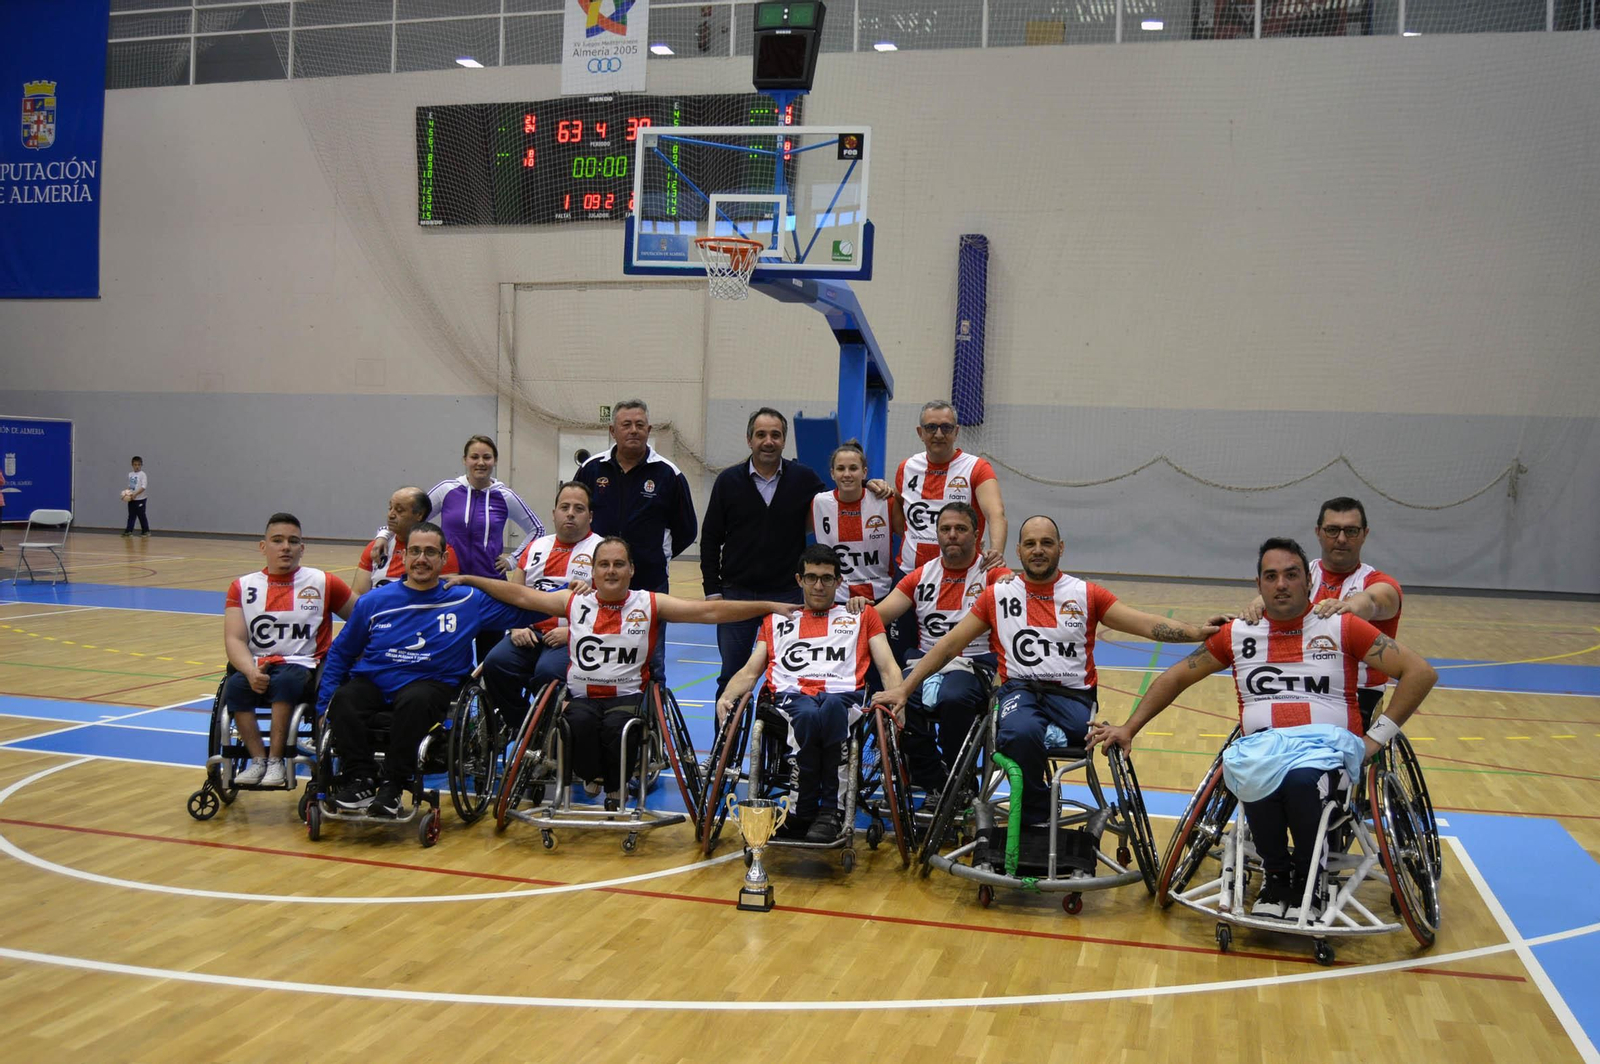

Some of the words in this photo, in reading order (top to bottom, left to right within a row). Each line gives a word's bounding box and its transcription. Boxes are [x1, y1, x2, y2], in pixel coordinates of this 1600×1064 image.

[613, 45, 638, 55] 2005
[525, 115, 535, 123] 21
[428, 128, 434, 136] 5
[557, 120, 583, 143] 63
[596, 122, 607, 139] 4
[427, 153, 433, 161] 8
[572, 156, 628, 178] 00:00
[9, 180, 93, 204] ALMERÍA
[564, 194, 570, 210] 1
[604, 192, 615, 209] 2
[907, 475, 918, 491] 4
[822, 516, 831, 535] 6
[869, 533, 886, 541] faam
[530, 552, 543, 567] 5
[571, 568, 589, 578] faam
[246, 586, 258, 604] 3
[917, 583, 936, 602] 12
[300, 603, 319, 612] faam
[577, 604, 591, 625] 7
[998, 596, 1022, 619] 18
[436, 612, 457, 633] 13
[776, 620, 795, 638] 15
[1064, 620, 1084, 629] faam
[834, 629, 854, 637] faam
[1241, 637, 1256, 659] 8
[1312, 653, 1337, 661] faam
